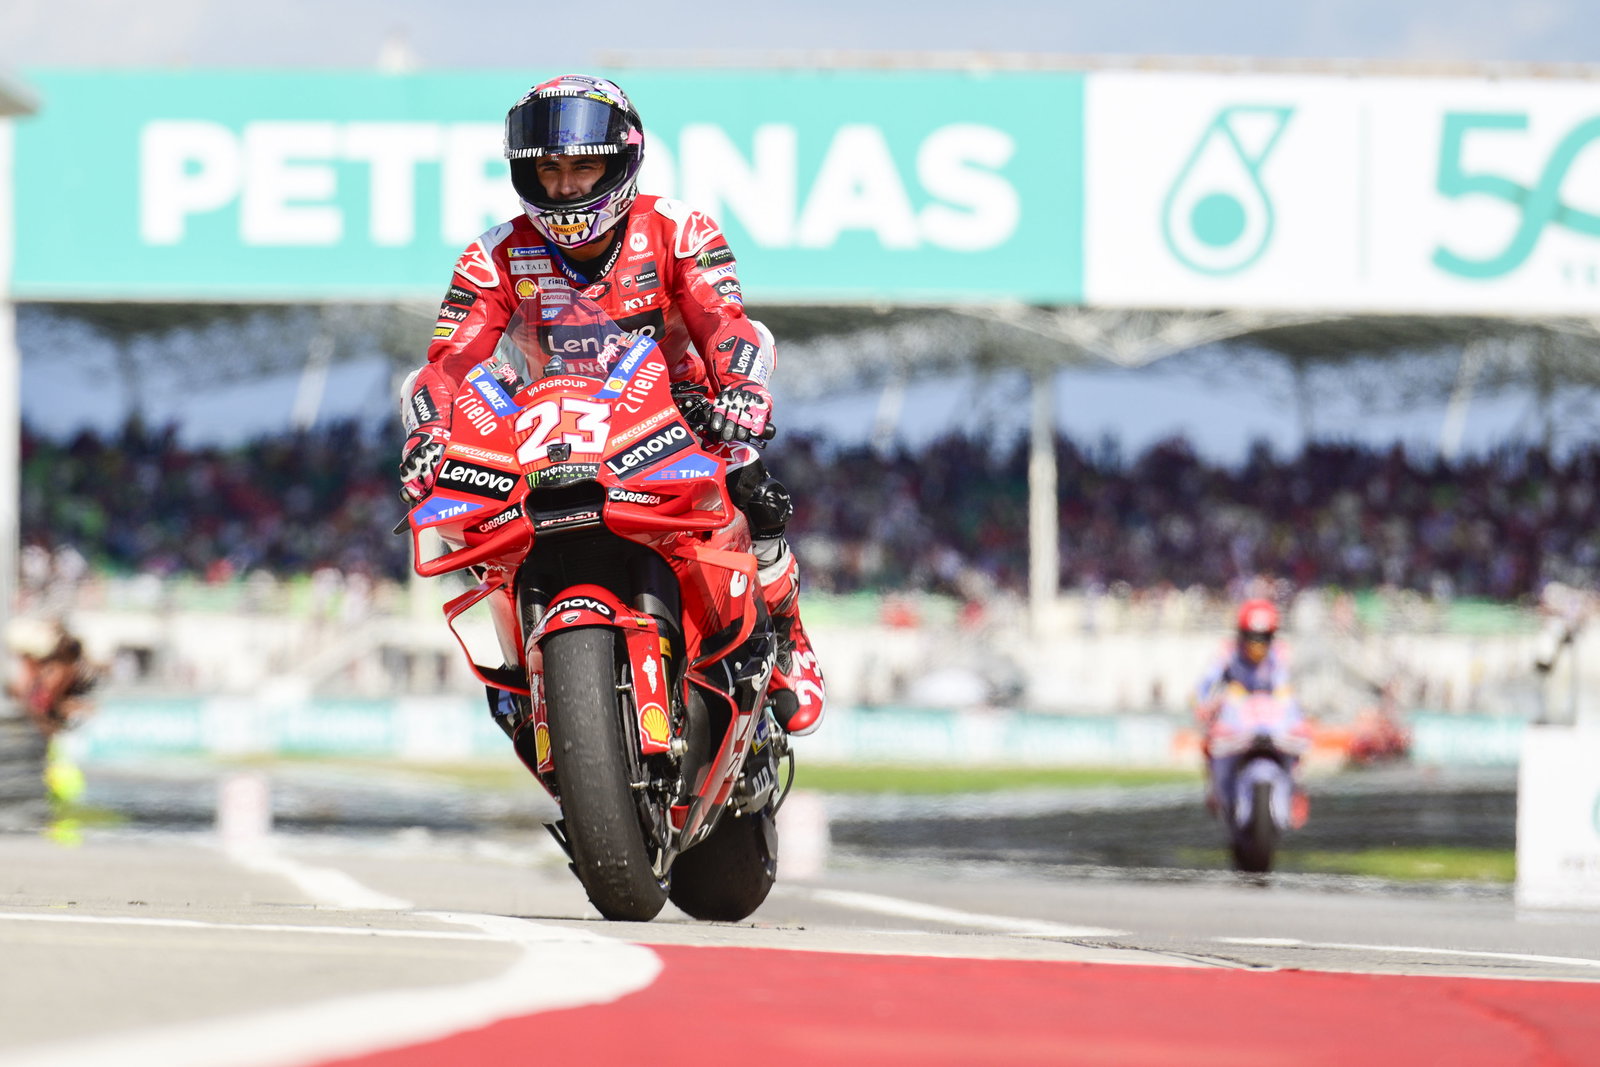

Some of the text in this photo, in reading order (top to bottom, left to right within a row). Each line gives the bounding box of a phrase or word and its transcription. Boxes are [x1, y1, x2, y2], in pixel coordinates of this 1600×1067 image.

[539, 90, 578, 99] TERRANOVA
[567, 144, 618, 156] TERRANOVA
[139, 119, 1021, 248] PETRNAS
[600, 241, 622, 277] Lenovo
[627, 251, 654, 262] motorola
[513, 263, 550, 271] EATALY
[562, 263, 577, 281] TIM
[635, 271, 656, 281] Lenovo
[623, 293, 657, 311] KYT
[541, 309, 558, 319] SAP
[620, 338, 652, 374] ADVANCE
[732, 344, 754, 374] Lenovo
[527, 379, 588, 397] VARGROUP
[413, 389, 432, 421] Lenovo
[515, 397, 611, 465] 23
[611, 407, 677, 447] FRECCIAROSSA
[449, 444, 514, 464] FRECCIAROSSA
[606, 426, 687, 475] Lenovo
[439, 460, 514, 492] Lenovo
[679, 469, 709, 477] TIM
[608, 490, 660, 505] CARRERA
[438, 503, 468, 519] TIM
[478, 508, 519, 533] CARRERA
[545, 598, 610, 619] enovo
